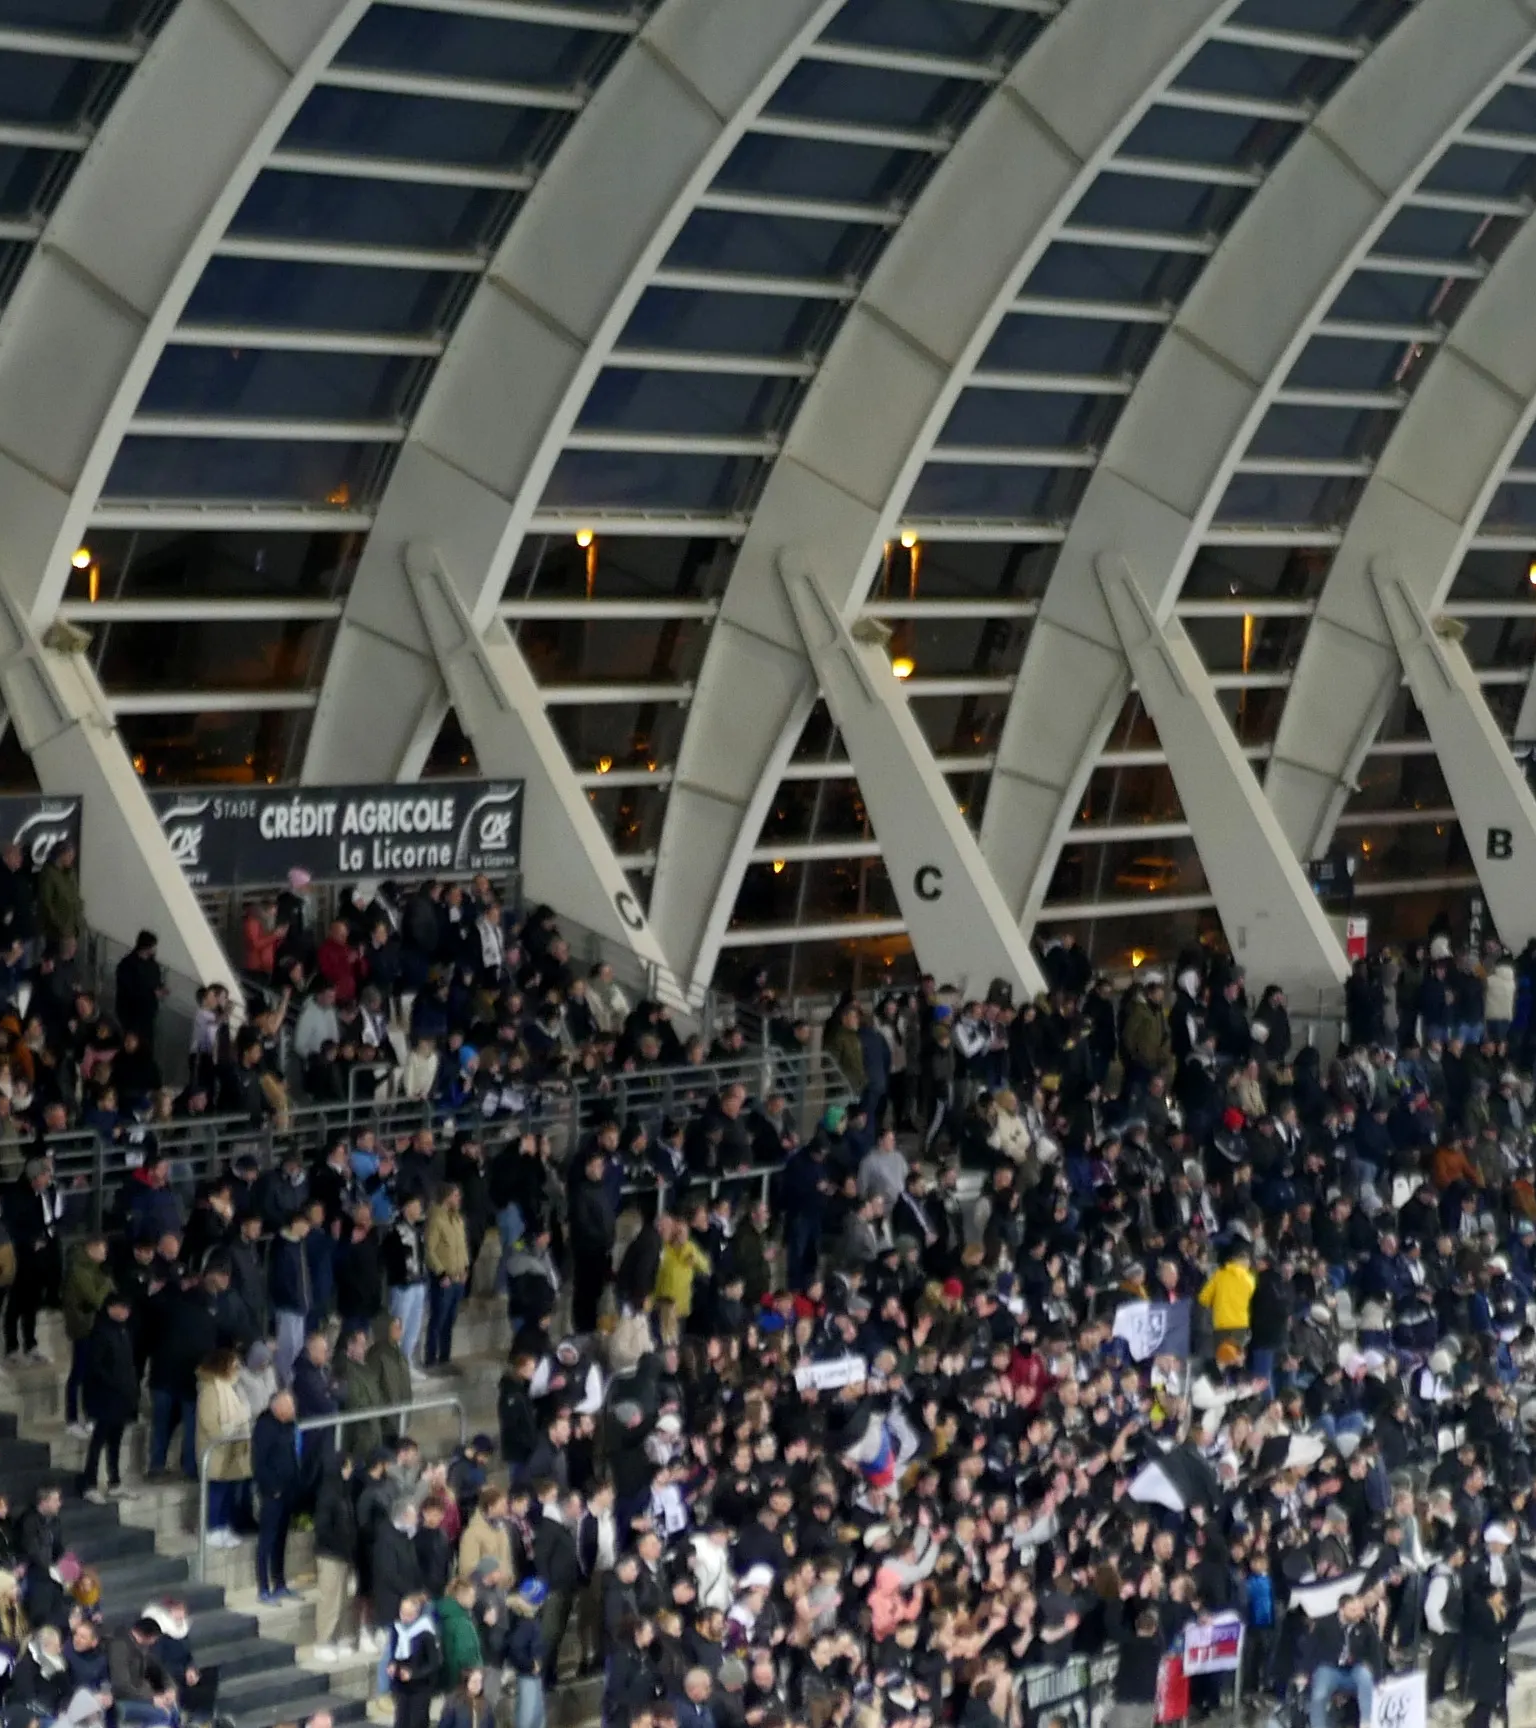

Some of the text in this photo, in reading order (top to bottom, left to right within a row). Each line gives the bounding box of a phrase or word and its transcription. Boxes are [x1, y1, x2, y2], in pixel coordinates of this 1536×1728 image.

[259, 796, 337, 840] CRÉDIT
[341, 799, 454, 834] AGRICOLE
[339, 838, 451, 871] La Licorne
[1486, 827, 1513, 860] B
[912, 864, 944, 901] C
[614, 890, 645, 932] C
